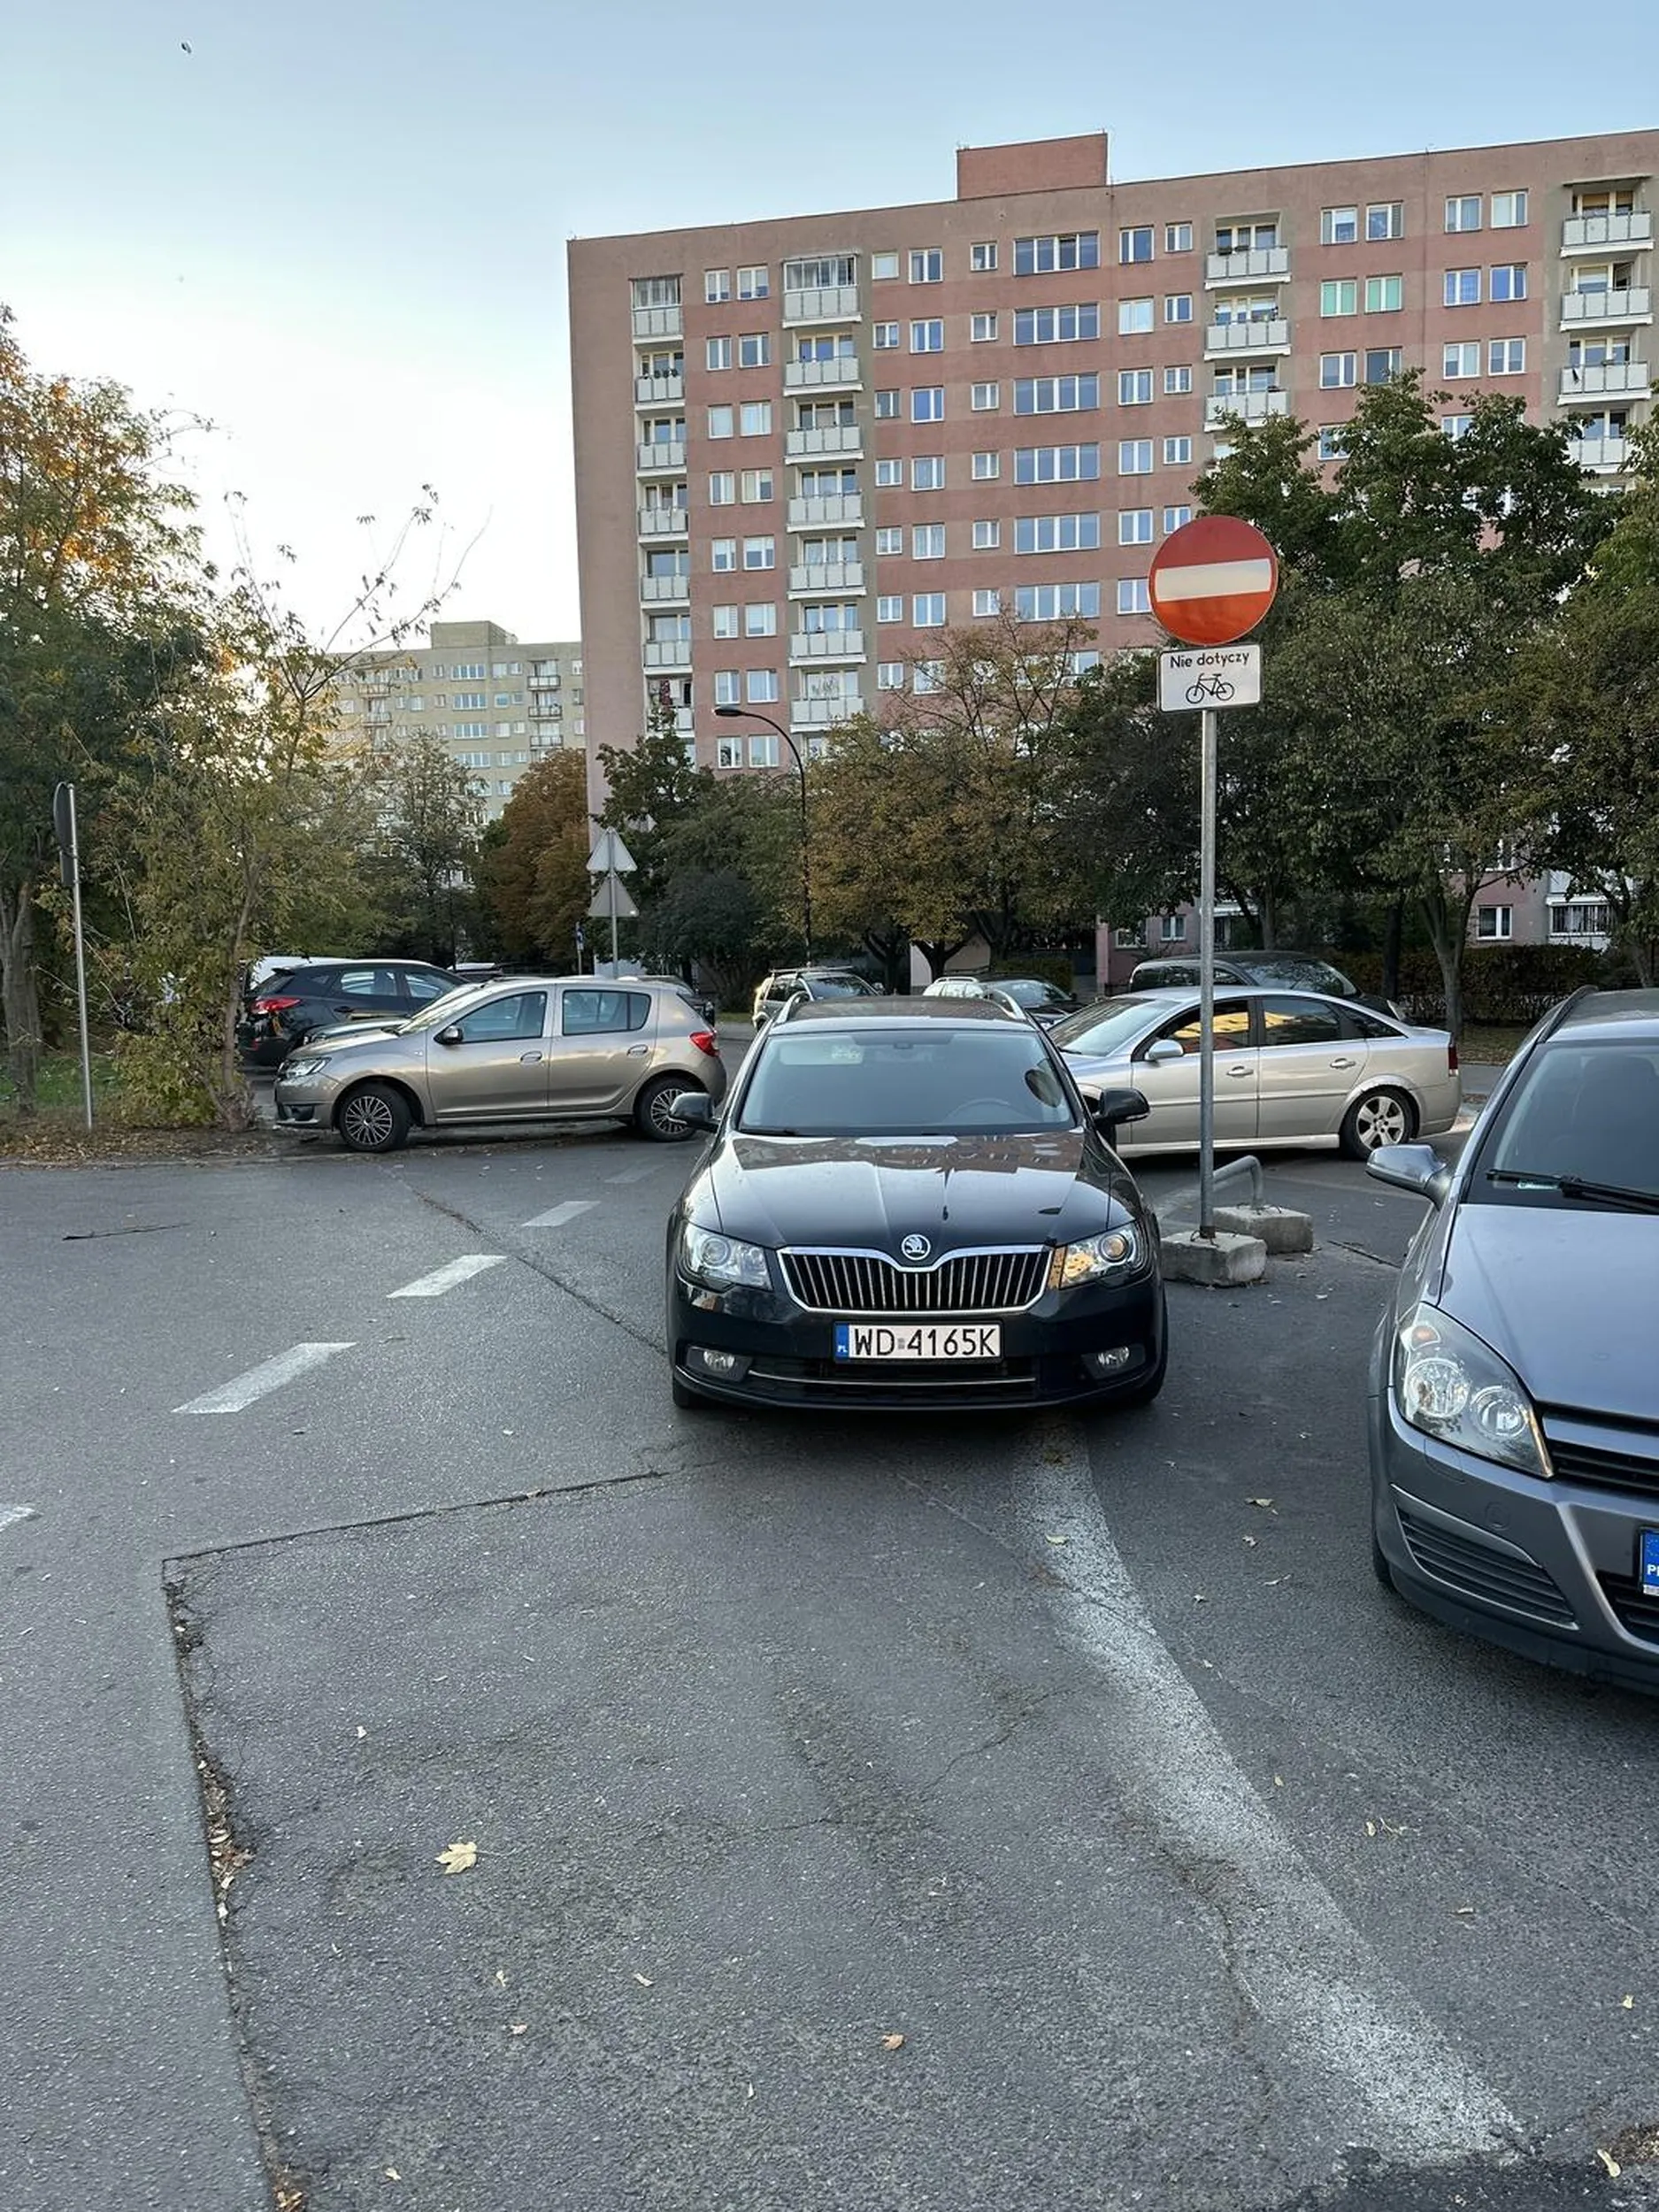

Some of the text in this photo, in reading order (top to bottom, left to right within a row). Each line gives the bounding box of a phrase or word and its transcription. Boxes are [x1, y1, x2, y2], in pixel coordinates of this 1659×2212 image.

[1170, 652, 1249, 669] Nie dotyczy
[854, 1328, 996, 1356] WD 4165K
